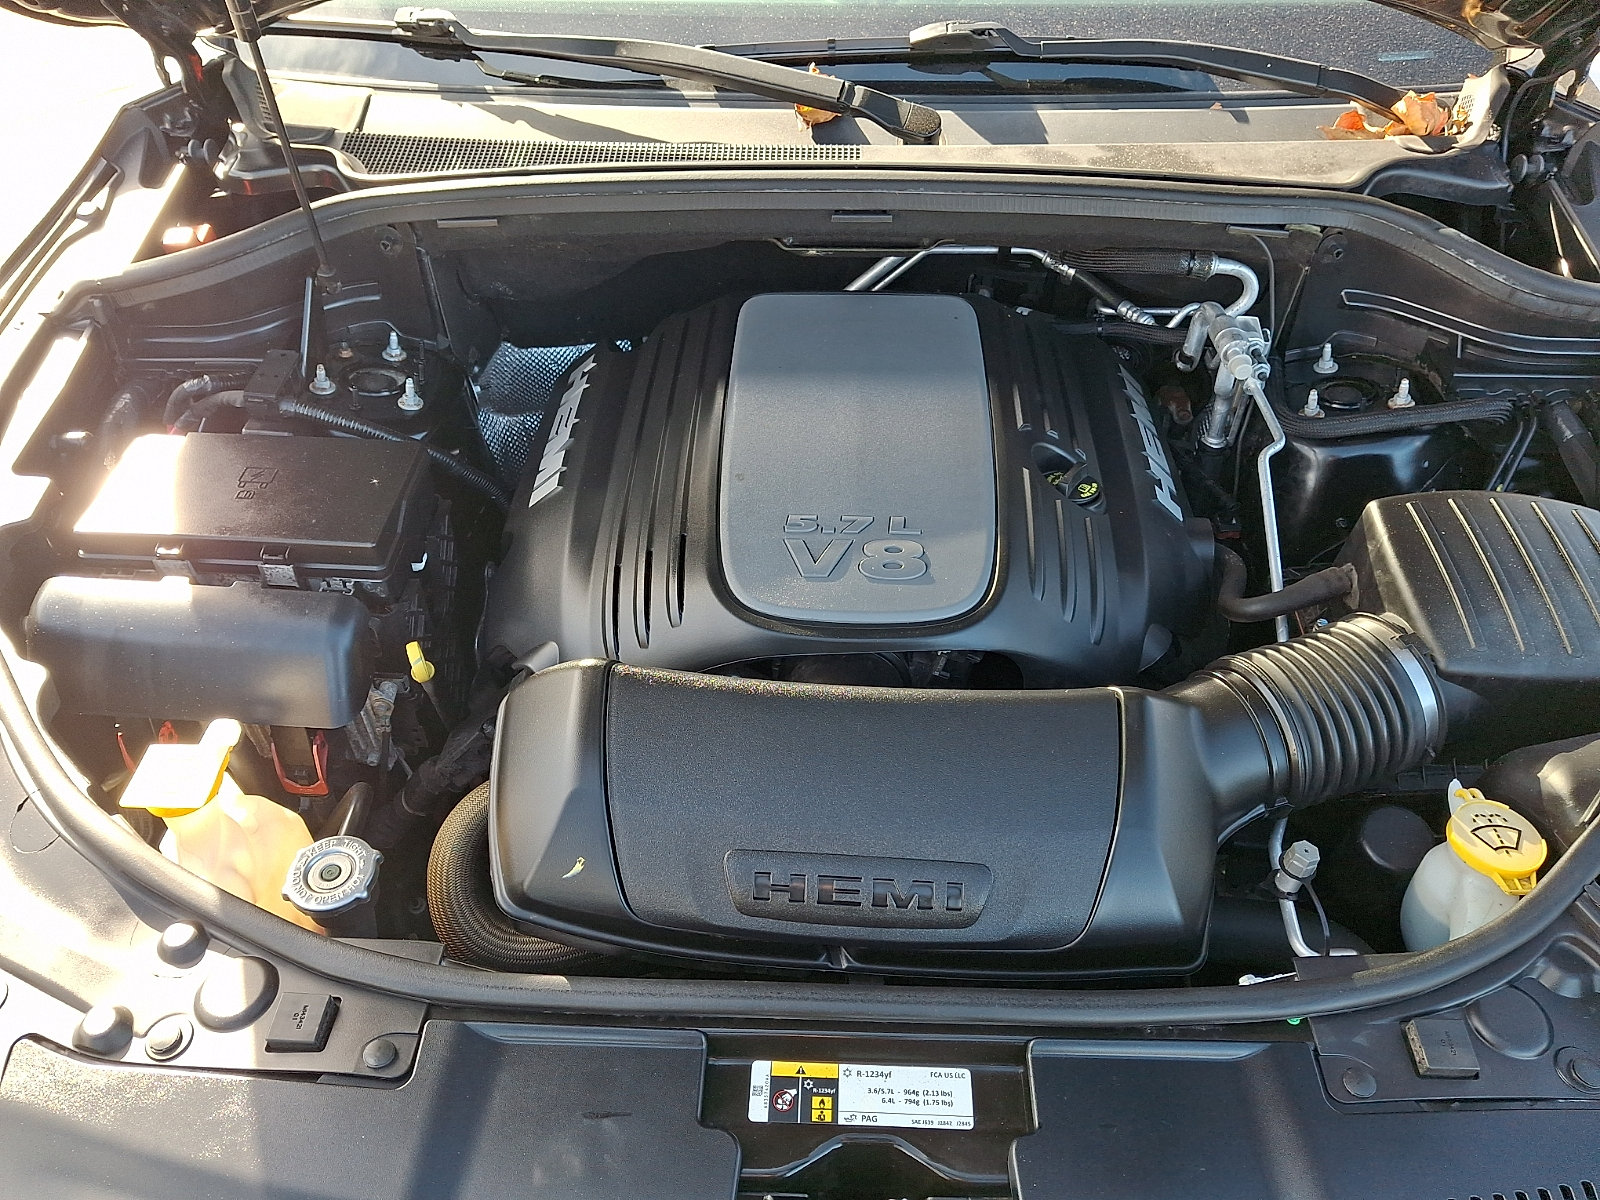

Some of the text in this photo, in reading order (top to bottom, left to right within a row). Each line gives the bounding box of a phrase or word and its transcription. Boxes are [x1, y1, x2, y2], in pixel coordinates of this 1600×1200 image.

[529, 354, 597, 508] HEMI
[1118, 363, 1184, 522] HEMI
[783, 514, 923, 535] 5.7 L
[783, 538, 928, 581] V8
[307, 839, 366, 857] KEEP TIGHT
[753, 872, 964, 911] HEMI
[856, 1070, 892, 1079] R-1234yf
[812, 1087, 836, 1095] R-1234yf
[903, 1089, 920, 1097] 964g
[922, 1089, 939, 1097] (2.13
[940, 1090, 953, 1098] lbs)
[941, 1099, 953, 1107] lbs)
[861, 1115, 878, 1123] PAG
